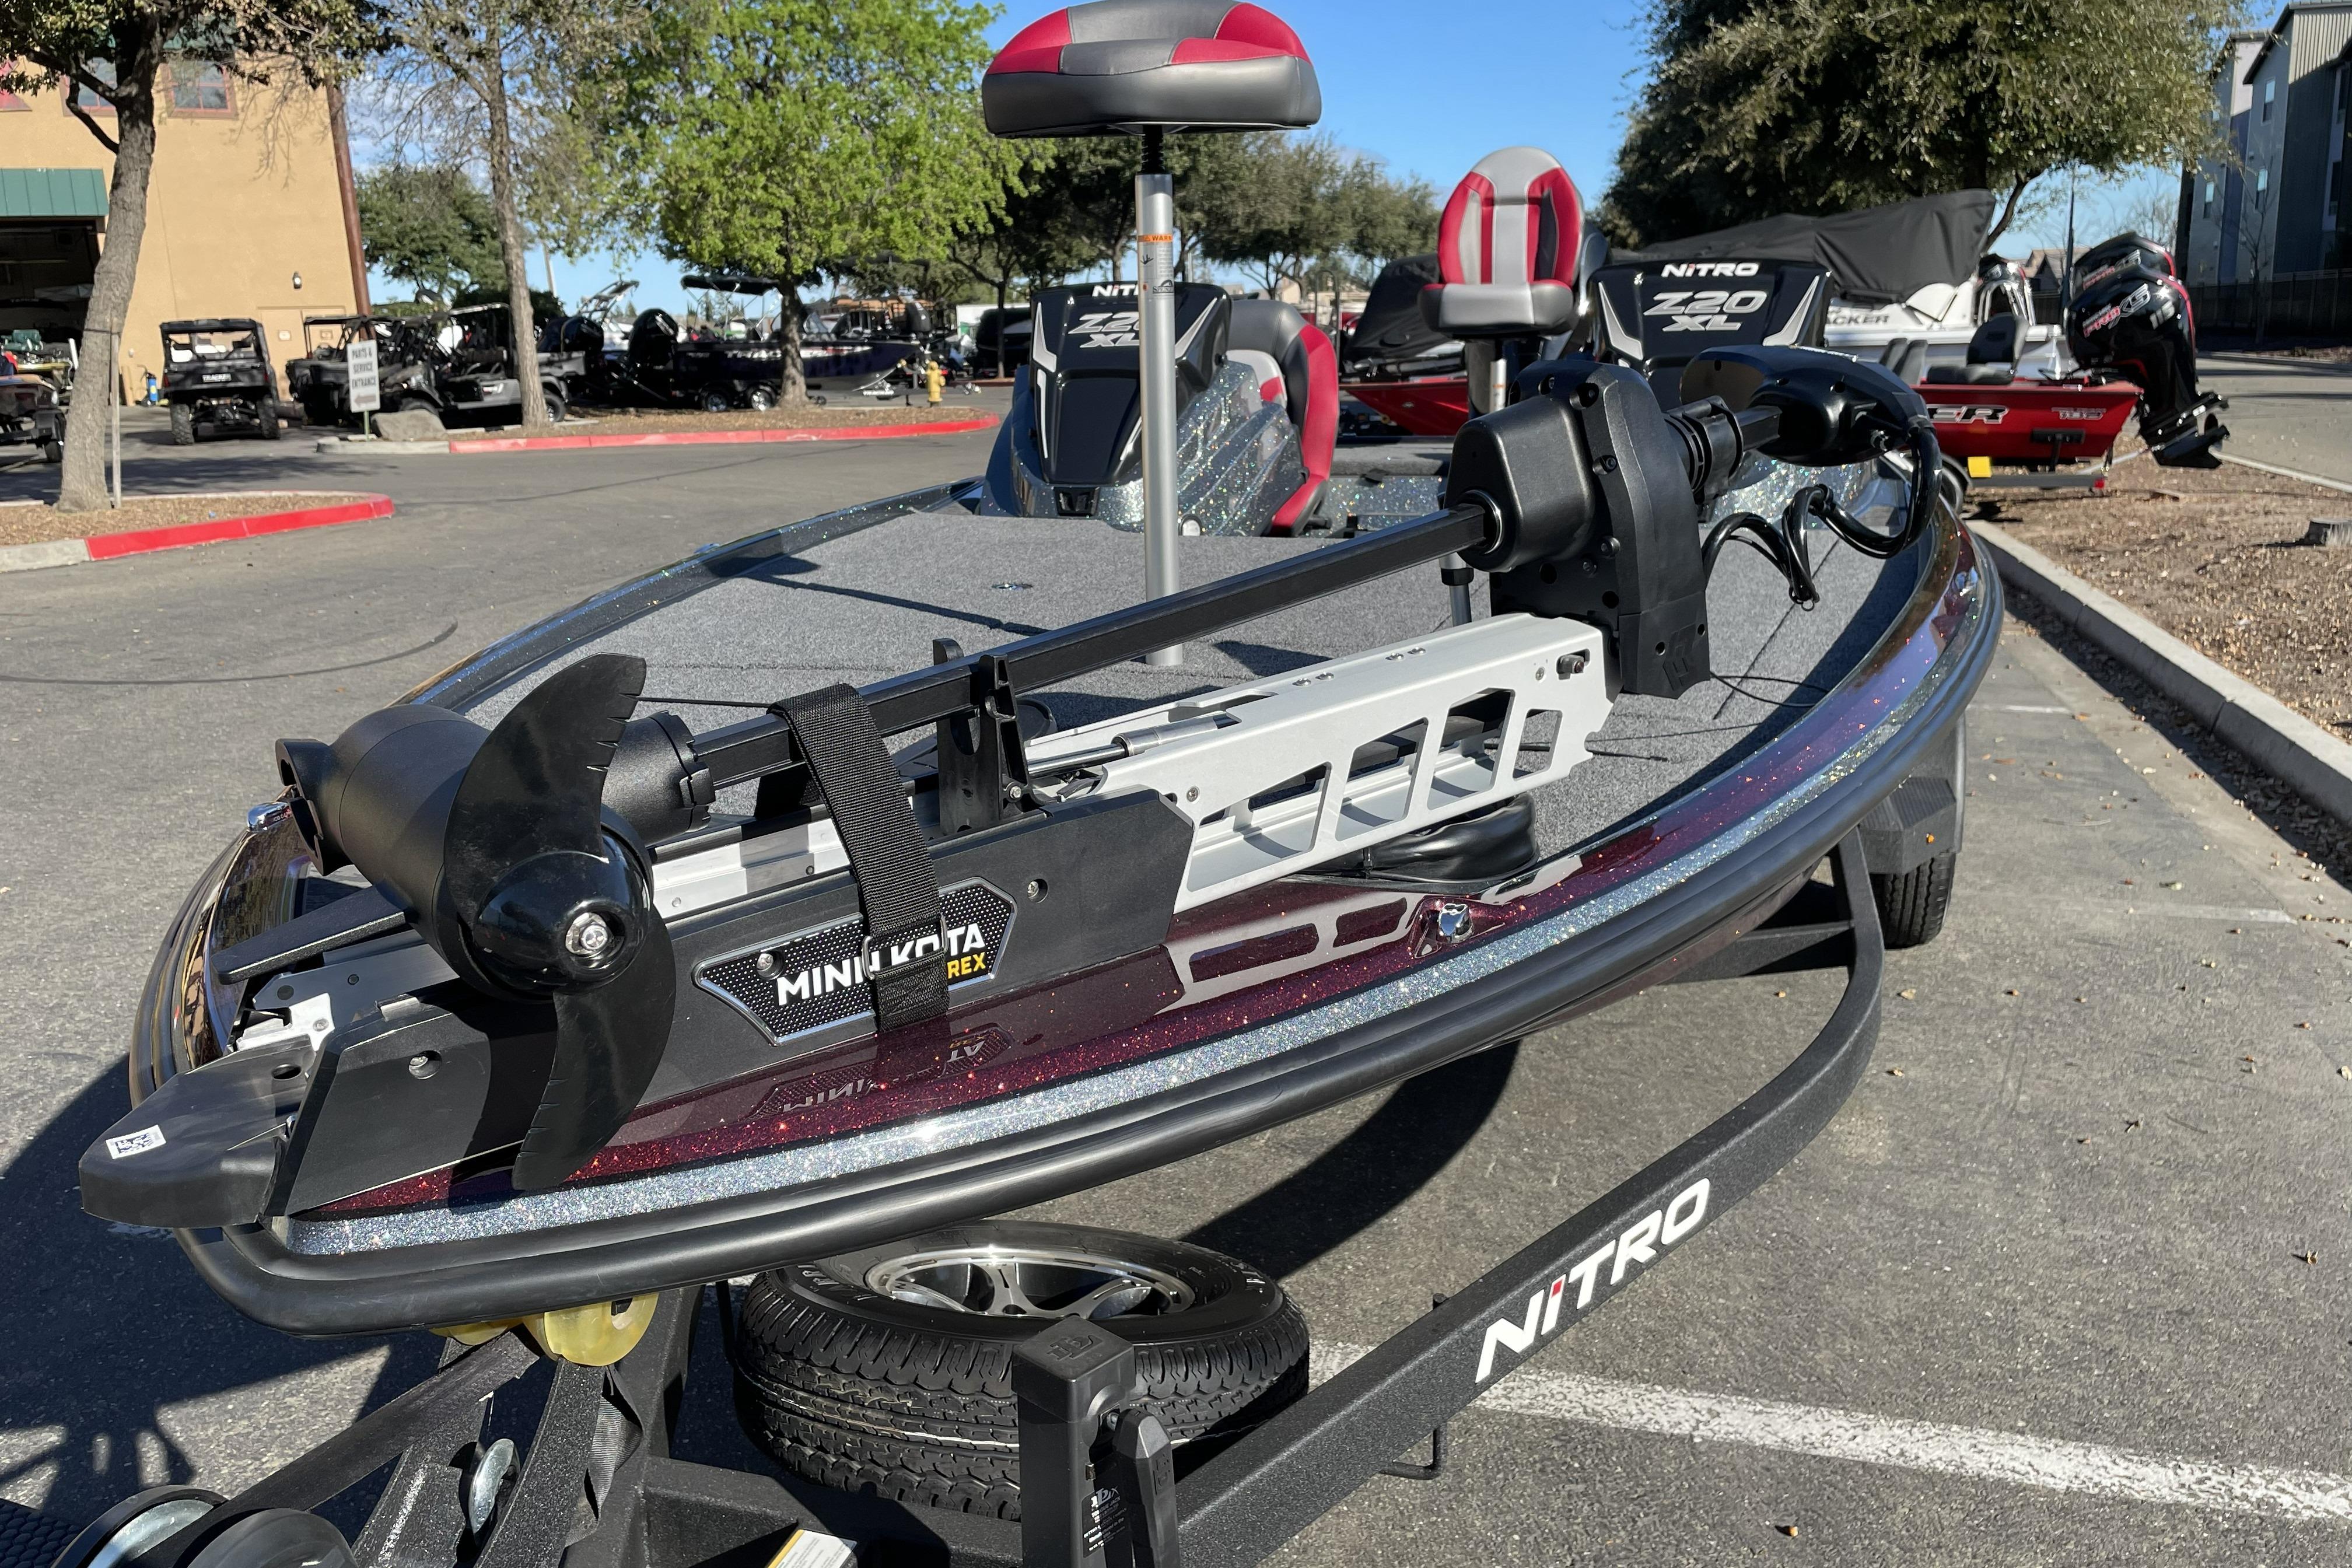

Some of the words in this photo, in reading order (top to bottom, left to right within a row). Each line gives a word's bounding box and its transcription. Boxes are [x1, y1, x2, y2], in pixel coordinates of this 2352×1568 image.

[1661, 262, 1759, 277] NITRO
[1092, 284, 1139, 297] NIT
[1643, 290, 1768, 316] Z20
[1068, 312, 1139, 334] Z2
[1662, 314, 1742, 332] XL
[1080, 333, 1139, 348] XL
[352, 348, 368, 360] PARTS
[353, 362, 373, 374] SERVICE
[352, 376, 376, 389] ENTRANCE
[946, 951, 986, 979] REX
[1475, 1177, 1710, 1384] NITRO
